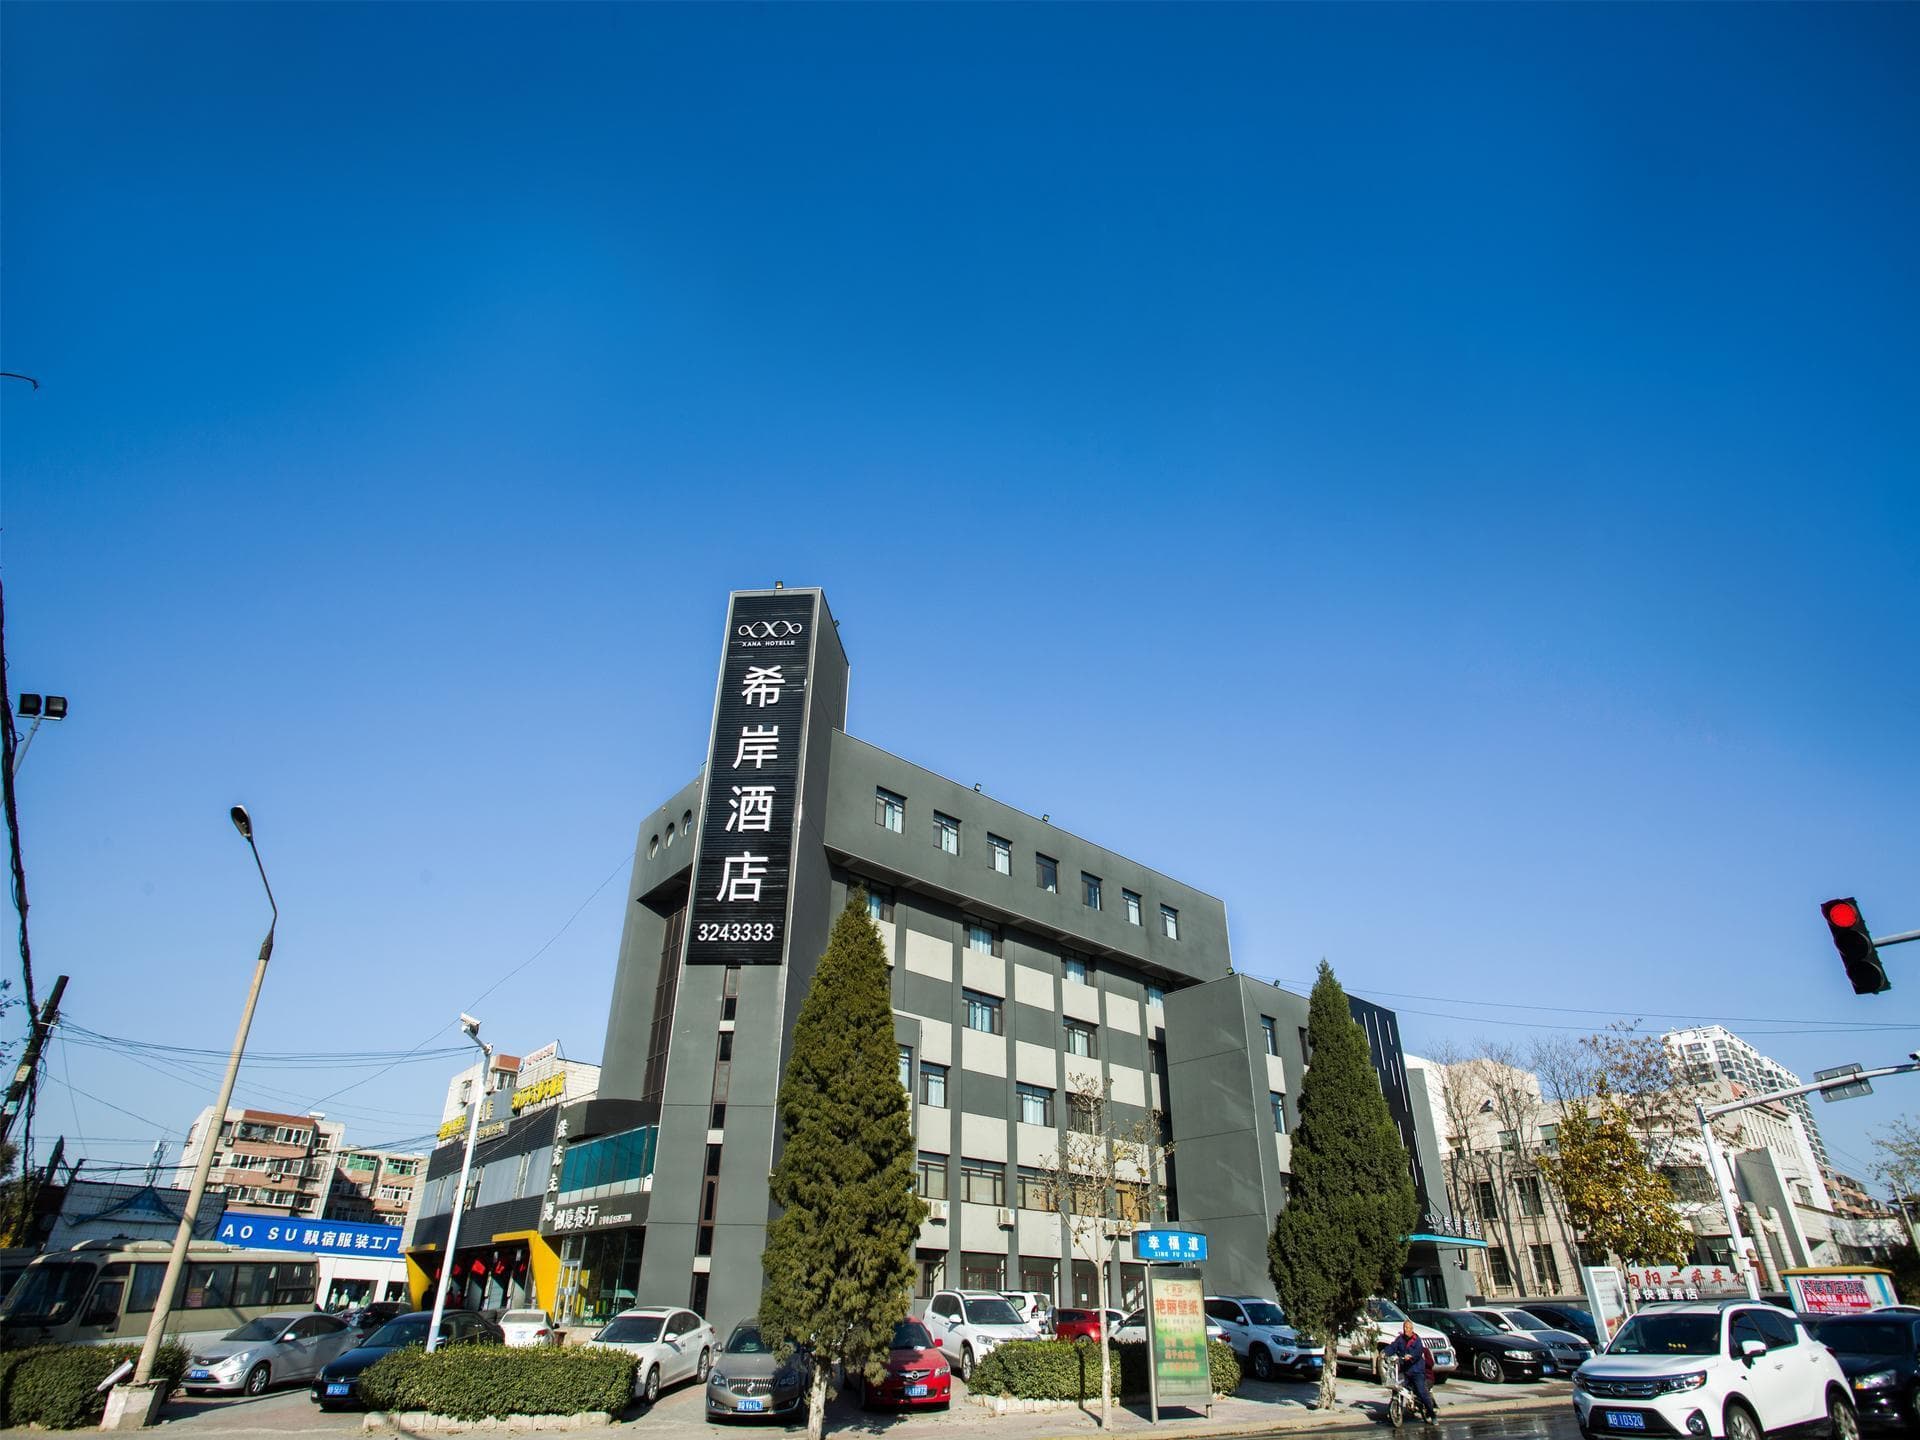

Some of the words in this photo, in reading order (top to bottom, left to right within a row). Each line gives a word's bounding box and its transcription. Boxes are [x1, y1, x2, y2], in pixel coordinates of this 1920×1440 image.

[716, 665, 786, 903] 希岸酒店
[697, 923, 774, 942] 3243333
[267, 1227, 298, 1242] SU
[1148, 1234, 1199, 1251] 幸福道
